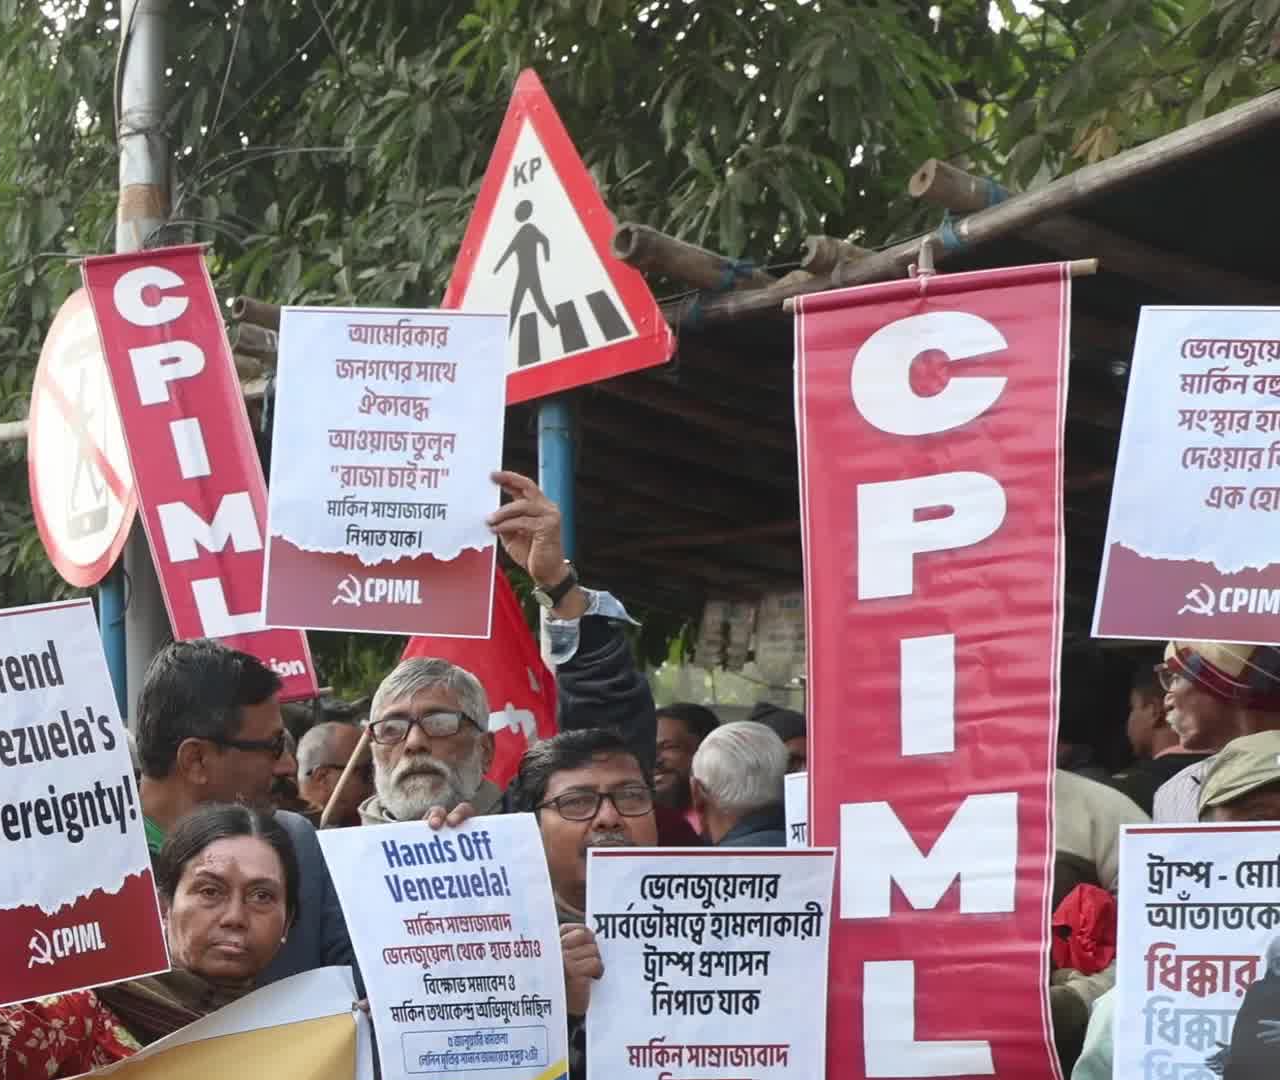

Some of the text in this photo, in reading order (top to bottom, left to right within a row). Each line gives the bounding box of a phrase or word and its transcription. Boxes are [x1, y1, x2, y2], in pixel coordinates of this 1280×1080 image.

[513, 158, 542, 188] KP
[348, 319, 450, 350] আমেরিকার
[335, 360, 457, 383] জনগণের সাথে
[1180, 366, 1249, 395] মার্কিন
[358, 387, 432, 421] ঐক্যবদ্ধ
[1178, 409, 1253, 437] সংস্থার
[328, 429, 456, 461] আওয়াজ তুলুন
[1182, 447, 1264, 472] দেওয়ার
[387, 462, 419, 490] চাই
[327, 494, 448, 521] মার্কিন সাম্রাজ্যবাদ
[1205, 486, 1246, 509] এক
[346, 525, 387, 546] নিপাত
[364, 579, 423, 604] CPIML
[382, 831, 493, 869] Hands Off
[384, 866, 511, 902] Venezuela!
[1147, 853, 1214, 895] ট্রাম্প
[640, 874, 781, 909] ভেনেজুয়েলার
[403, 911, 444, 936] মার্কিন
[594, 901, 824, 945] সার্বভৌমত্বে হামলাকারী
[52, 922, 106, 958] CPIML
[456, 942, 486, 961] থেকে
[488, 941, 512, 960] হাত
[643, 944, 770, 982] ট্রাম্প প্রশাসন
[468, 976, 507, 992] সমাবেশ
[509, 975, 516, 991] ও
[390, 1000, 426, 1023] মার্কিন
[521, 994, 552, 1019] মিছিল
[651, 982, 761, 1016] নিপাত যাক
[626, 1037, 790, 1068] মার্কিন সাম্রাজ্যবাদ
